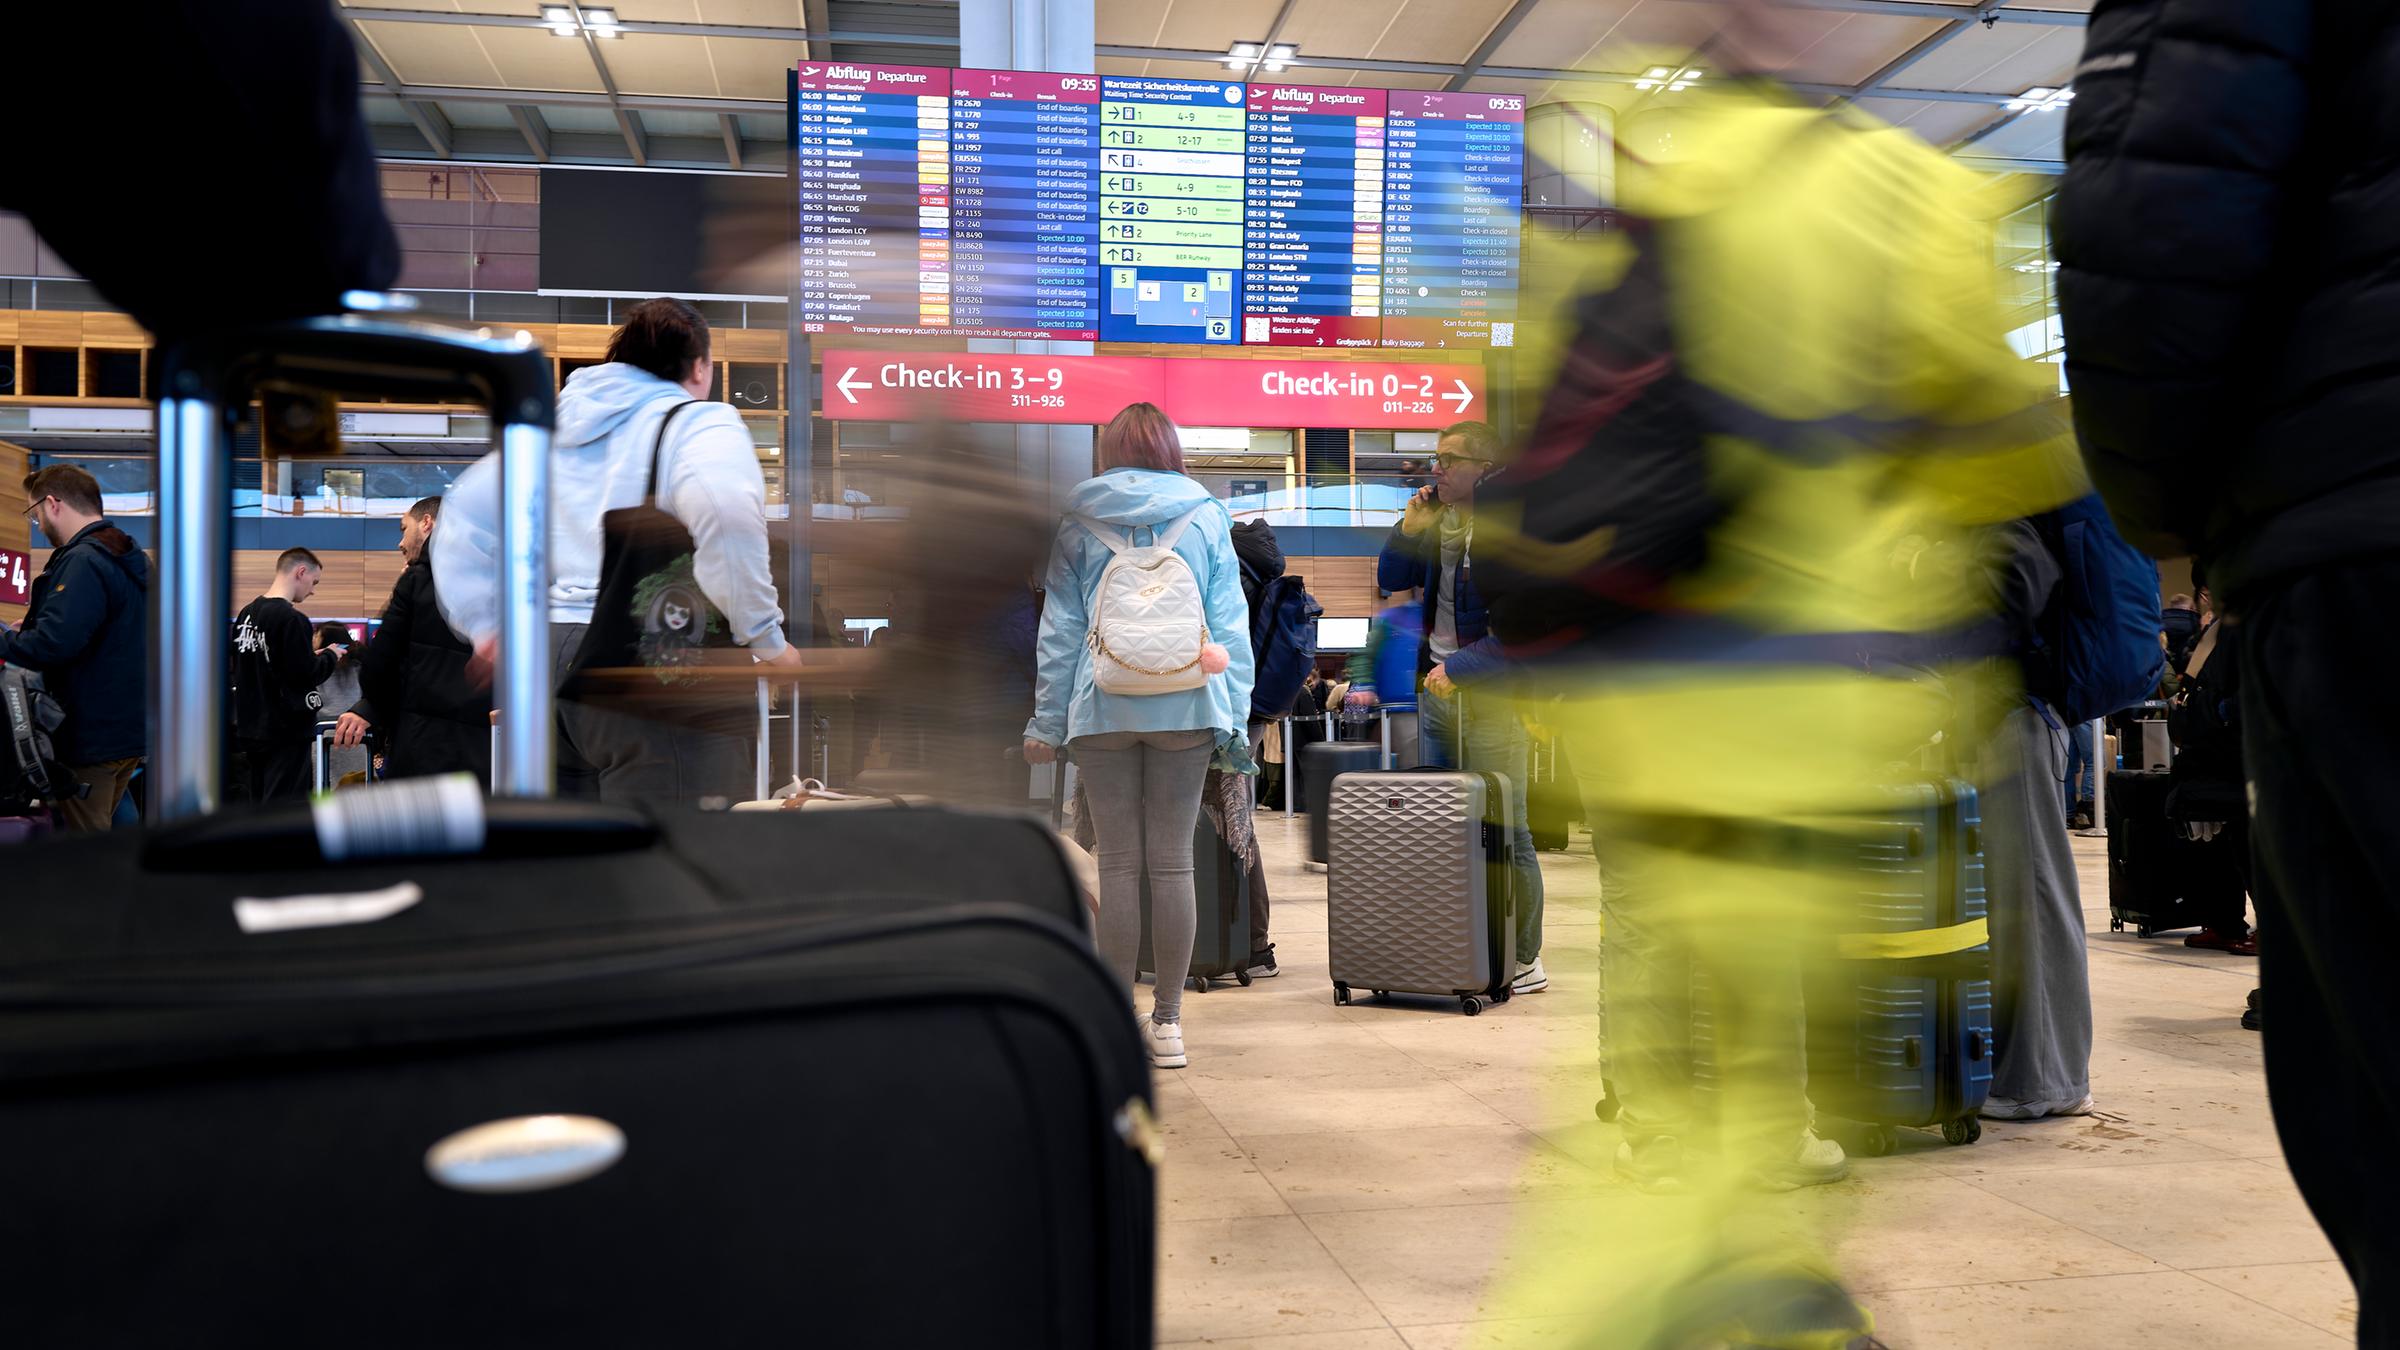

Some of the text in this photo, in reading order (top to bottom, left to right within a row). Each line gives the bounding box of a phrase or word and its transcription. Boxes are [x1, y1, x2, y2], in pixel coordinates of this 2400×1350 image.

[826, 66, 926, 84] Abflug Departure
[991, 75, 996, 86] 1
[1061, 78, 1096, 91] 09:35
[1104, 80, 1141, 89] Wartezeit
[1104, 90, 1127, 98] Waiting
[1272, 89, 1365, 104] Abflug Departure
[1423, 96, 1431, 106] 2
[1489, 98, 1521, 110] 09:35
[1138, 112, 1142, 120] 1
[1138, 135, 1202, 145] 2 12-17
[827, 183, 861, 191] Hurghada
[1138, 182, 1142, 191] 5
[1137, 229, 1142, 237] 2
[1137, 253, 1142, 261] 2
[1121, 274, 1126, 283] 5
[1218, 277, 1222, 285] 1
[1147, 286, 1152, 294] 4
[1191, 288, 1196, 297] 2
[829, 293, 870, 301] Copenhagen
[805, 324, 824, 332] BER
[867, 327, 881, 335] may
[914, 328, 939, 336] security
[880, 362, 1001, 389] Check-in
[1261, 371, 1374, 396] Check-in
[12, 556, 27, 595] 4
